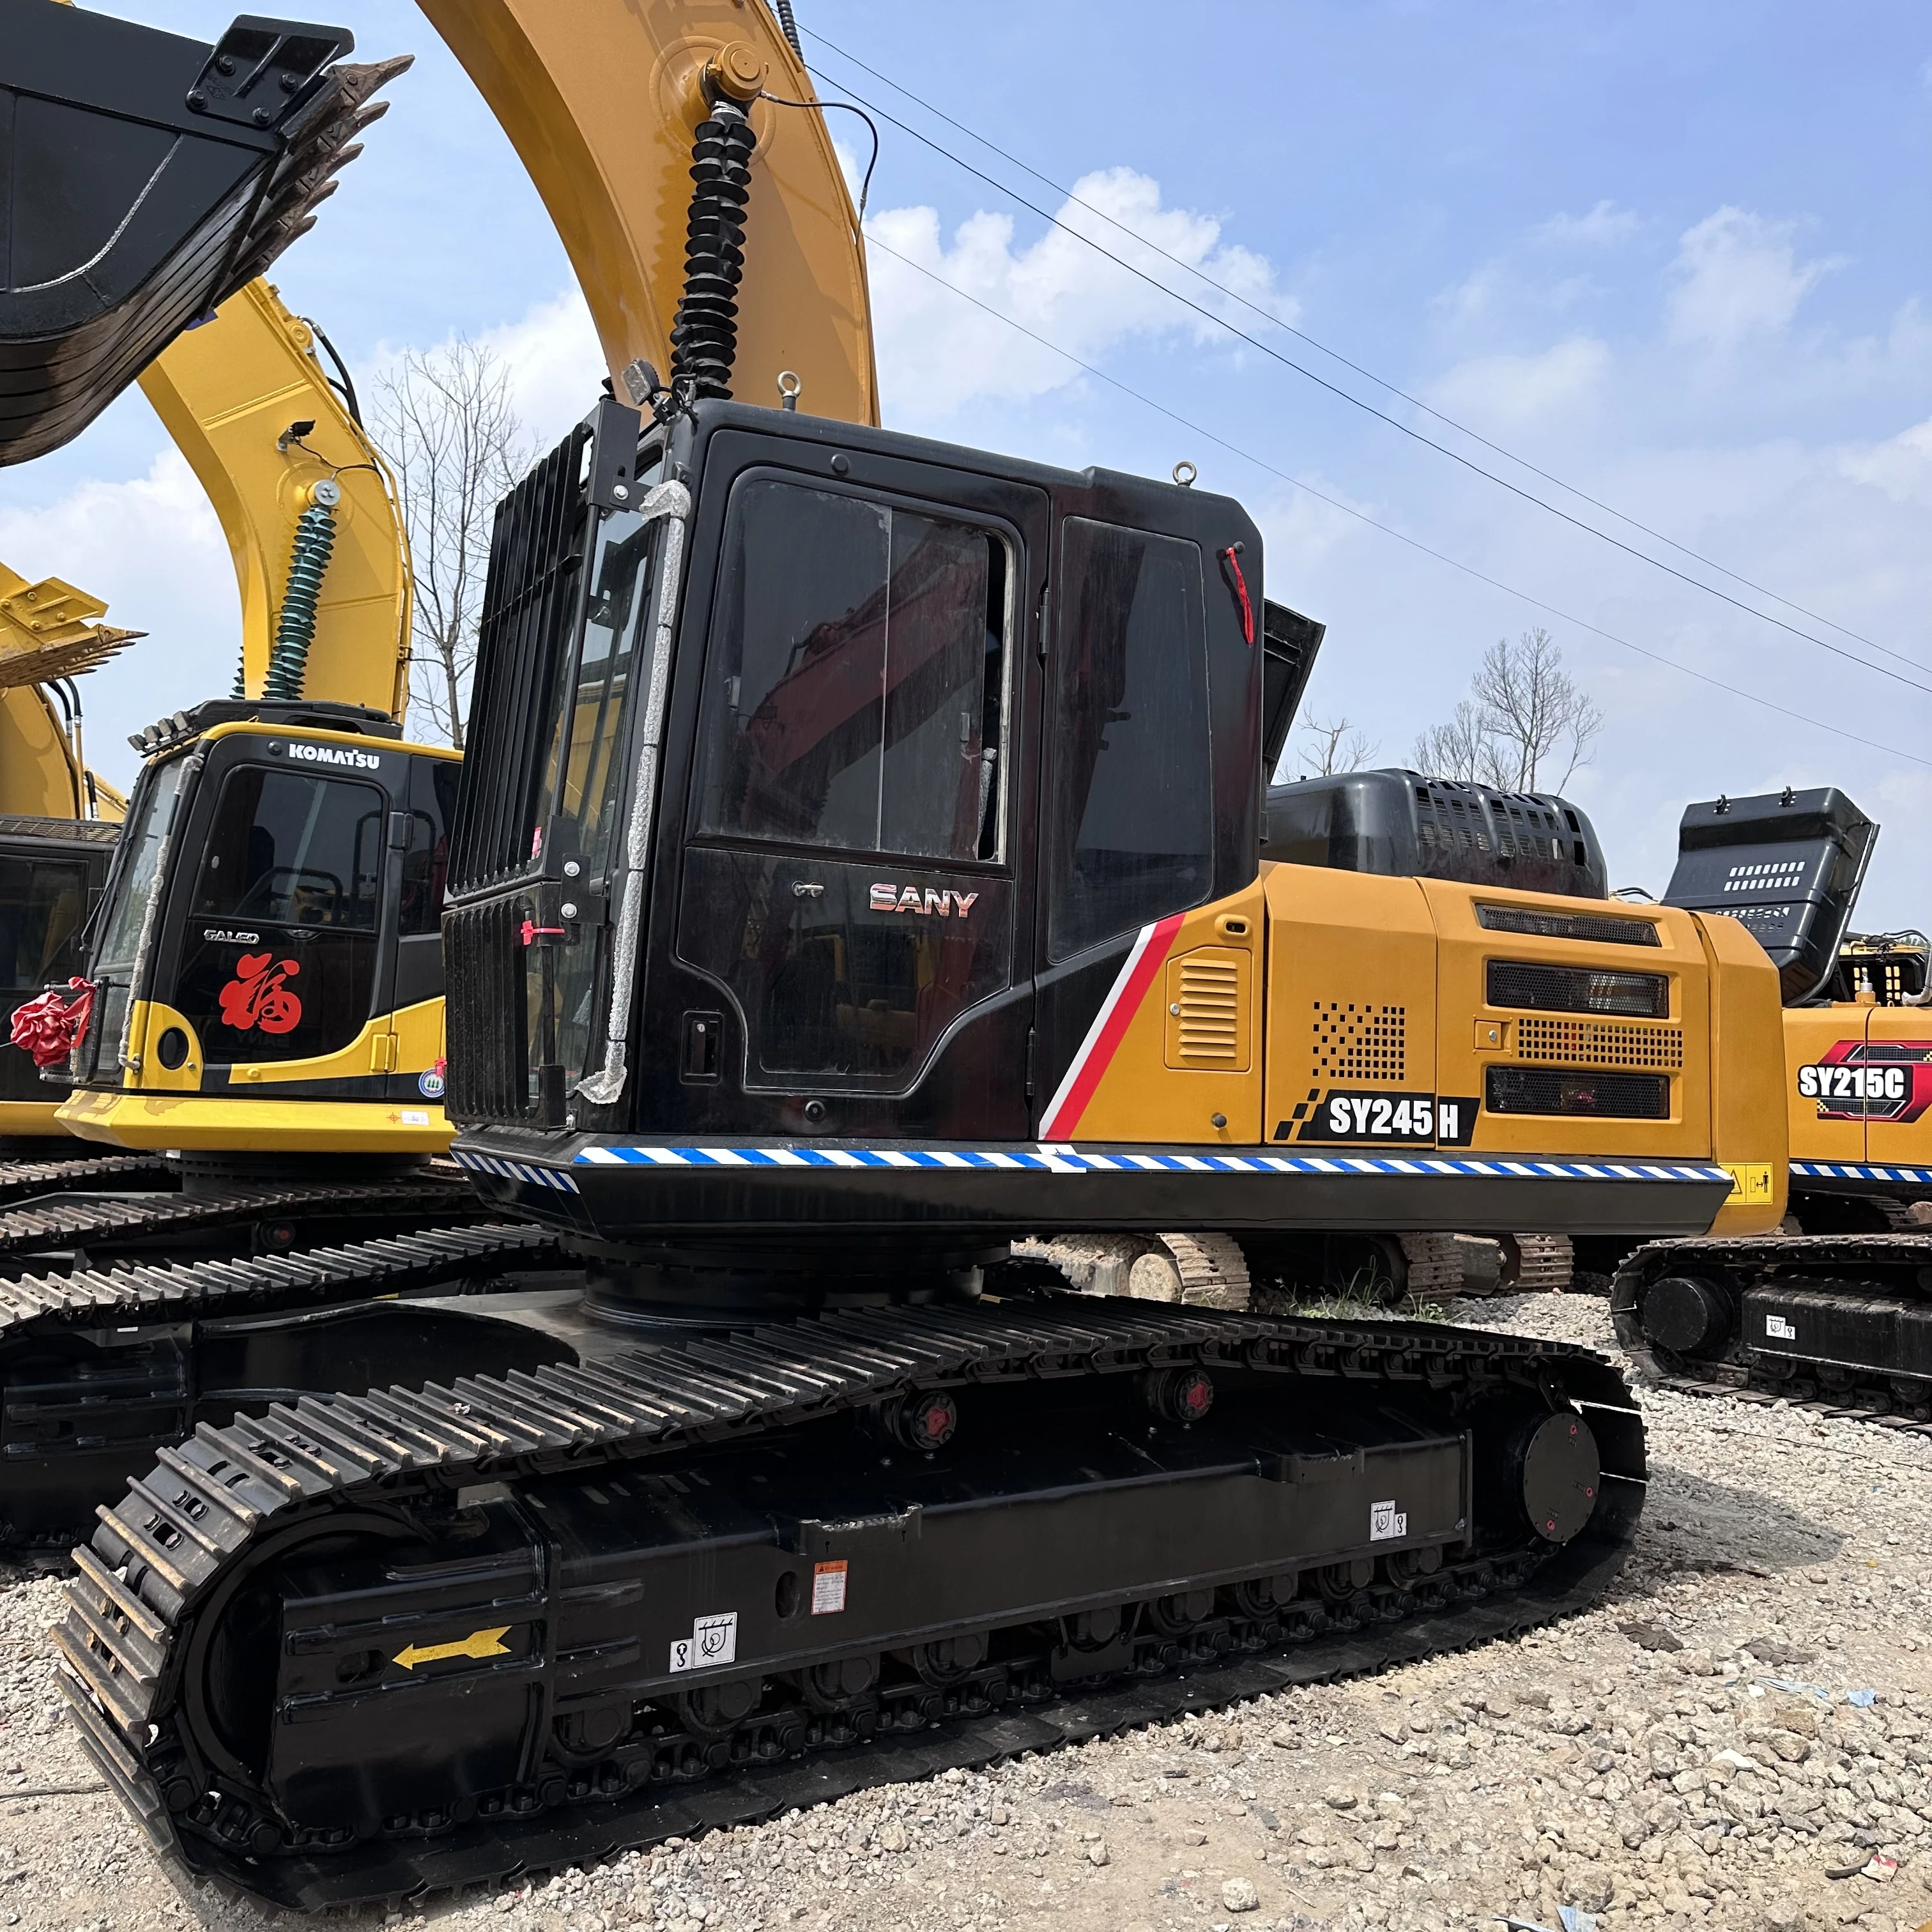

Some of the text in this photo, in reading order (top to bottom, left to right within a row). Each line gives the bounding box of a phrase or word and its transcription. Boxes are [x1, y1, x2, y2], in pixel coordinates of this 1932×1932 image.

[289, 743, 380, 769] KOMATSU
[870, 883, 979, 918] SANY
[204, 929, 260, 944] GALEO
[1800, 1066, 1905, 1099] SY215C
